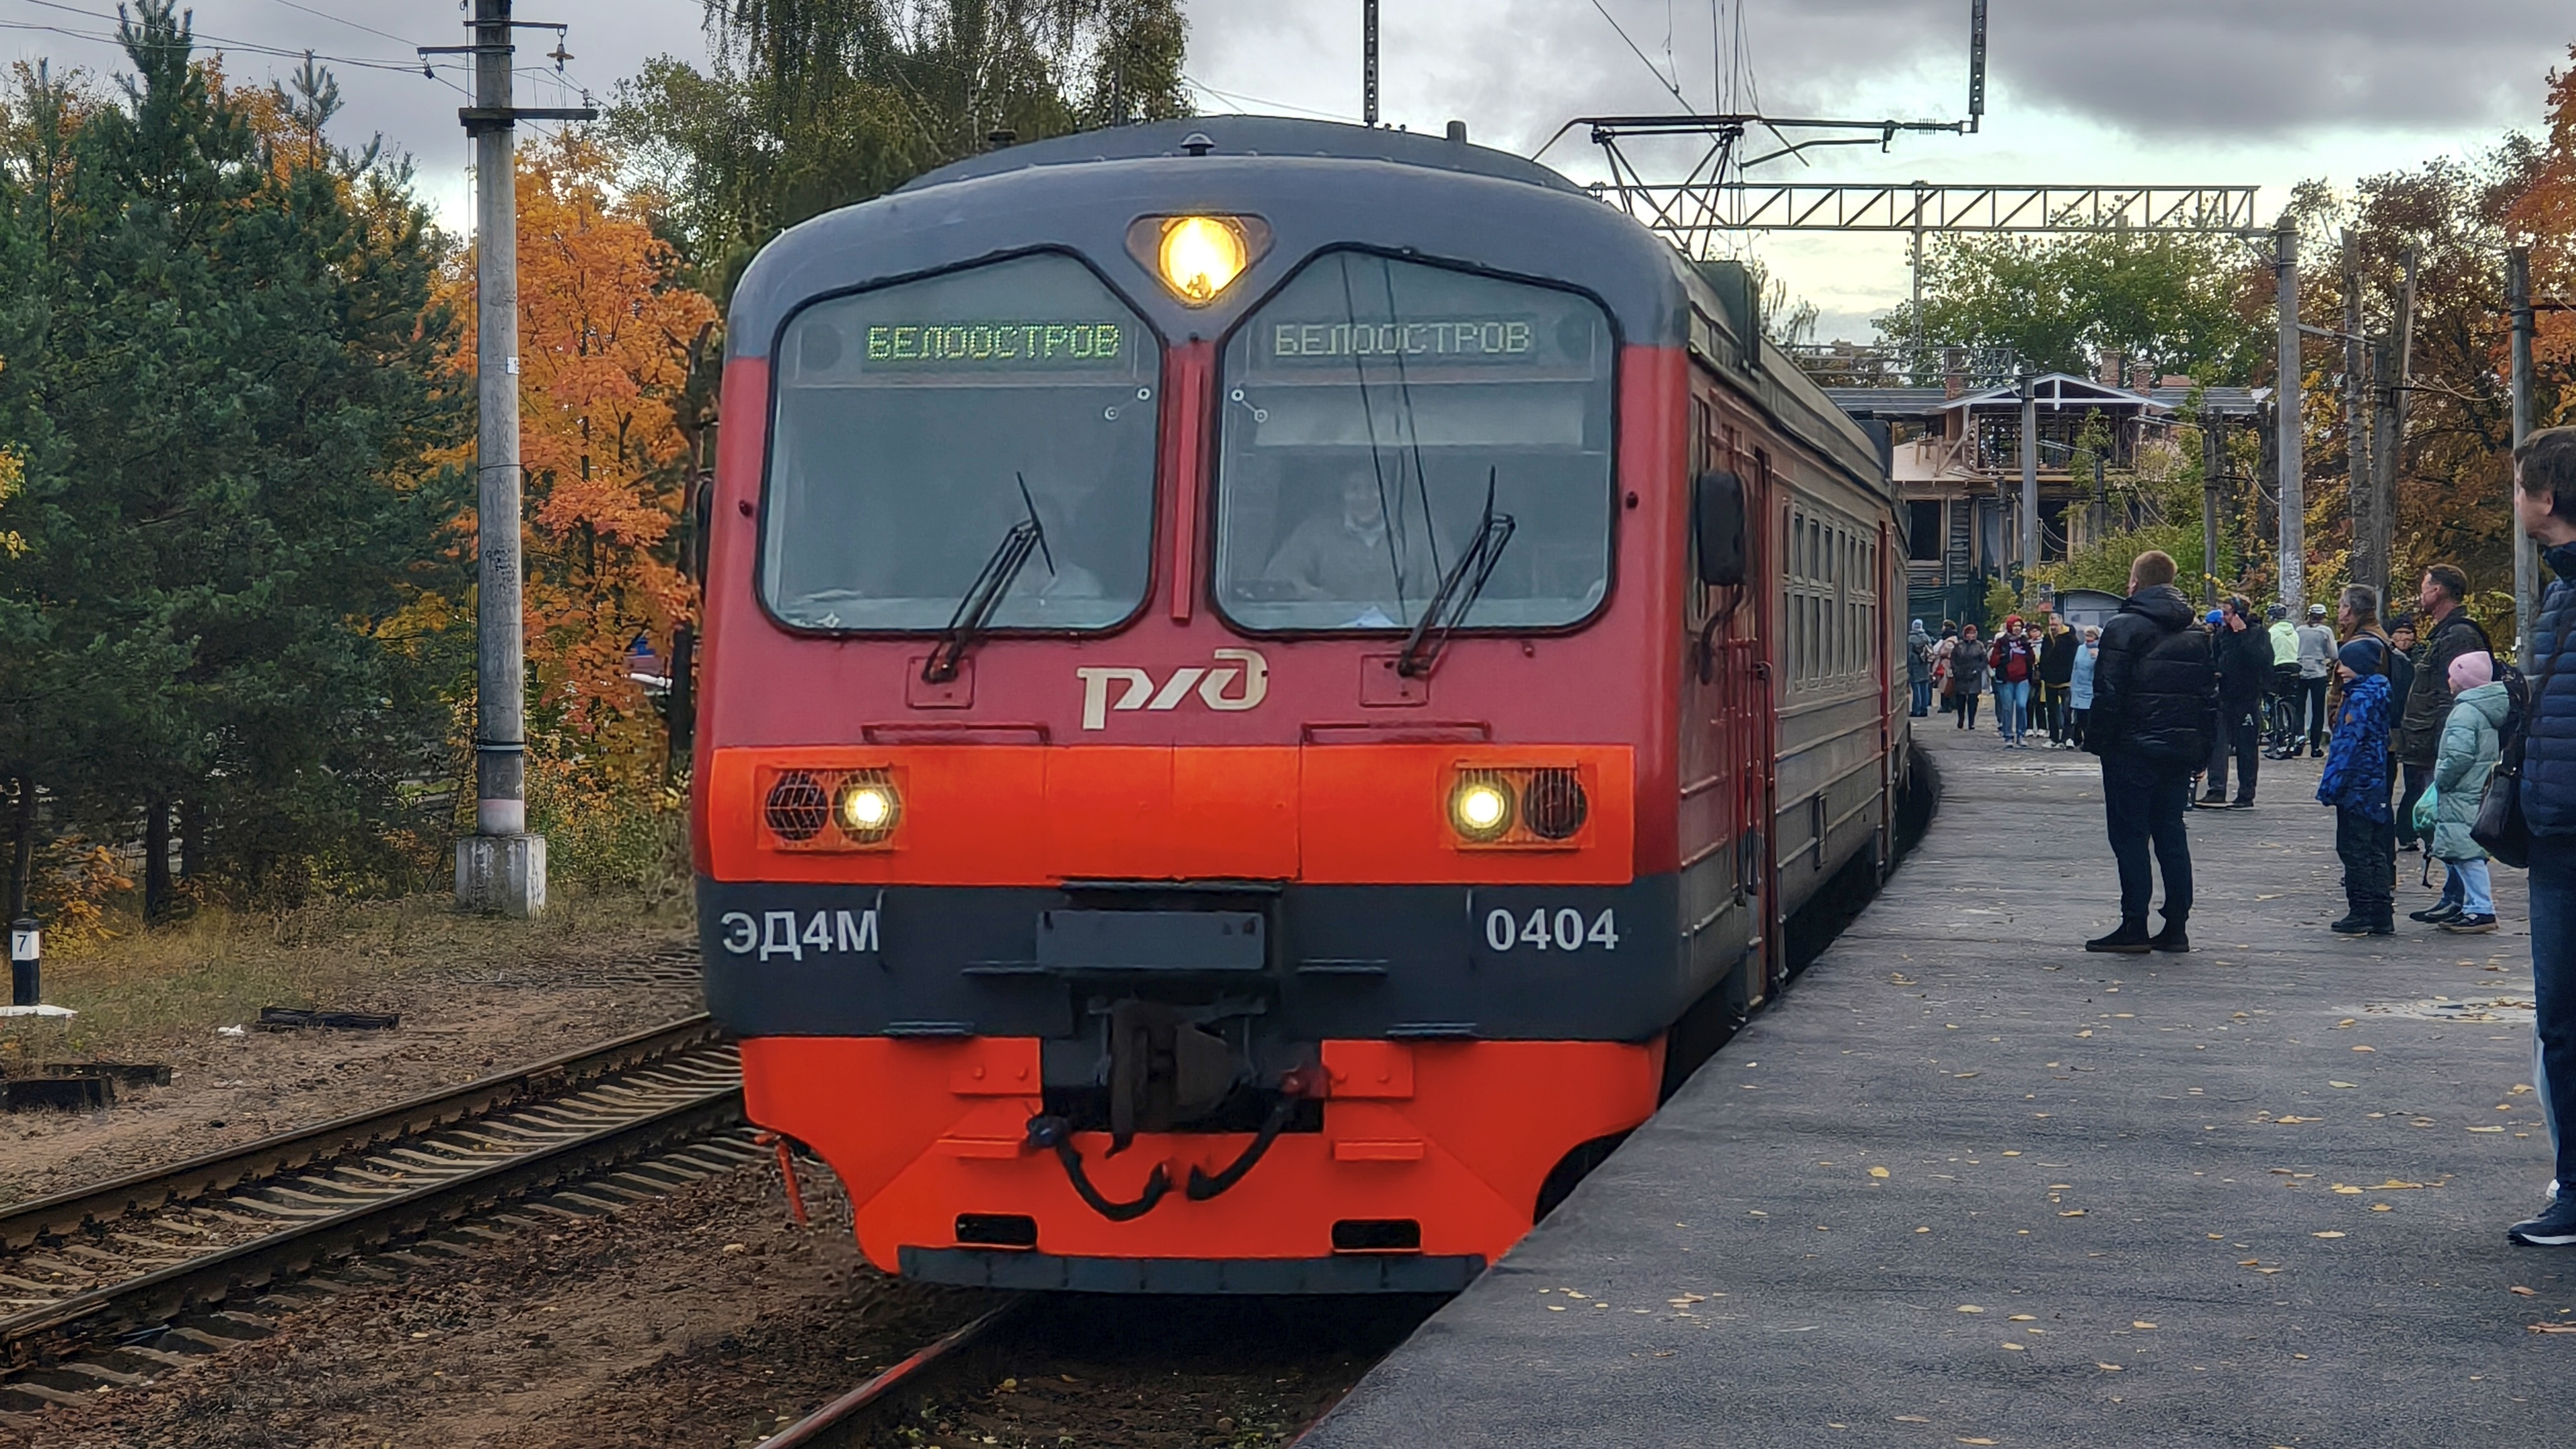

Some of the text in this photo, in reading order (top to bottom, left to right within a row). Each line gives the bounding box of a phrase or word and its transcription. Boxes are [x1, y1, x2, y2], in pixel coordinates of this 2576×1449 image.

[869, 325, 1119, 358] БЕЛООСТРОВ
[1275, 322, 1530, 355] БЕЛООСТРОВ
[17, 935, 27, 952] 7
[720, 910, 879, 961] ЭД4М
[1485, 908, 1619, 950] 0404
